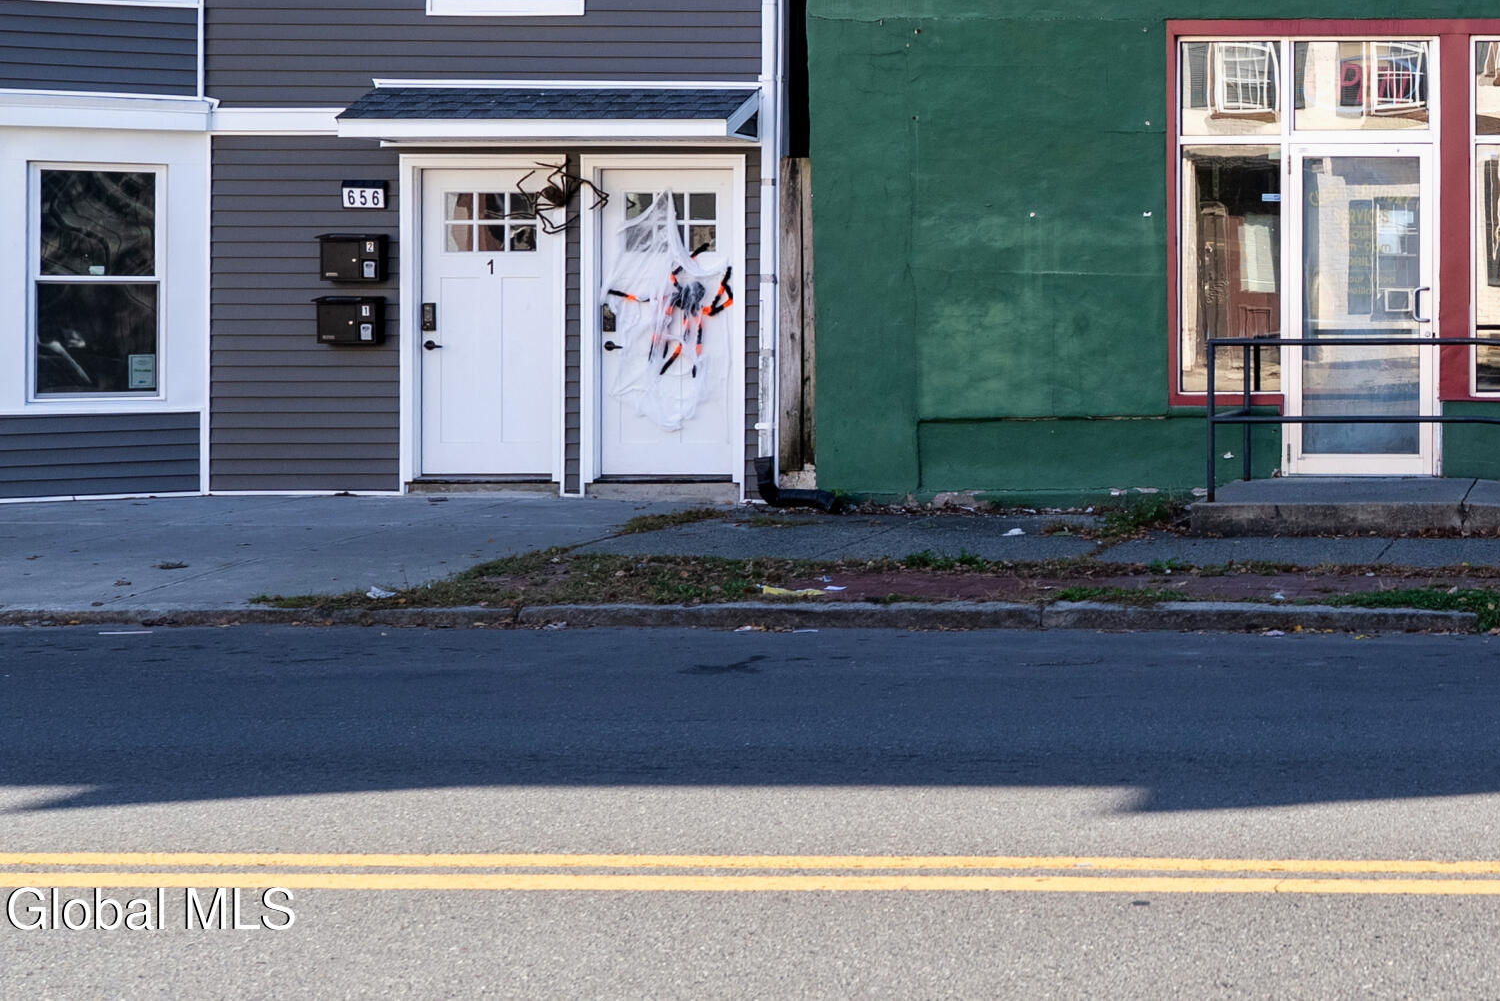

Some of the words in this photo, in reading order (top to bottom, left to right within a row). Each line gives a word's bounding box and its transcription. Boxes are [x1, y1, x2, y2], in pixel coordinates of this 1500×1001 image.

[347, 190, 380, 206] 656
[367, 242, 374, 252] 2
[487, 259, 494, 275] 1
